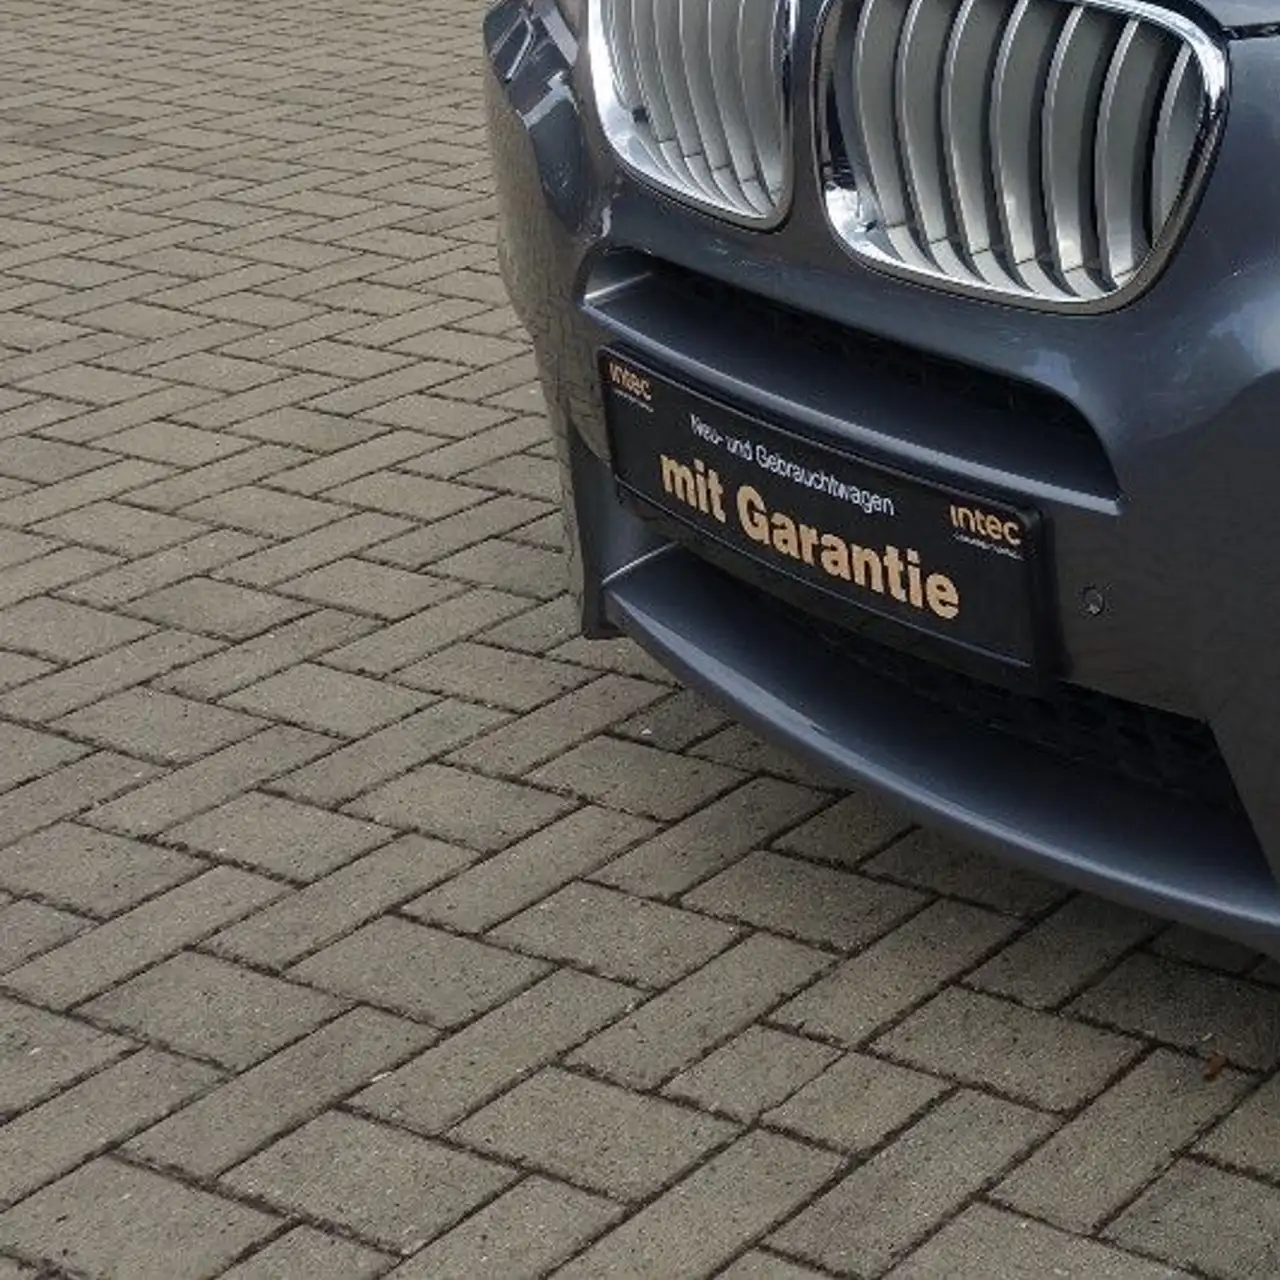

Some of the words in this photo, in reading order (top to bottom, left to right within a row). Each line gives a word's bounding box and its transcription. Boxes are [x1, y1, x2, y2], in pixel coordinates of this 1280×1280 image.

[660, 453, 726, 524] mit
[736, 484, 960, 620] Garantie
[725, 435, 753, 461] und
[755, 443, 896, 517] Gebrauchtwagen
